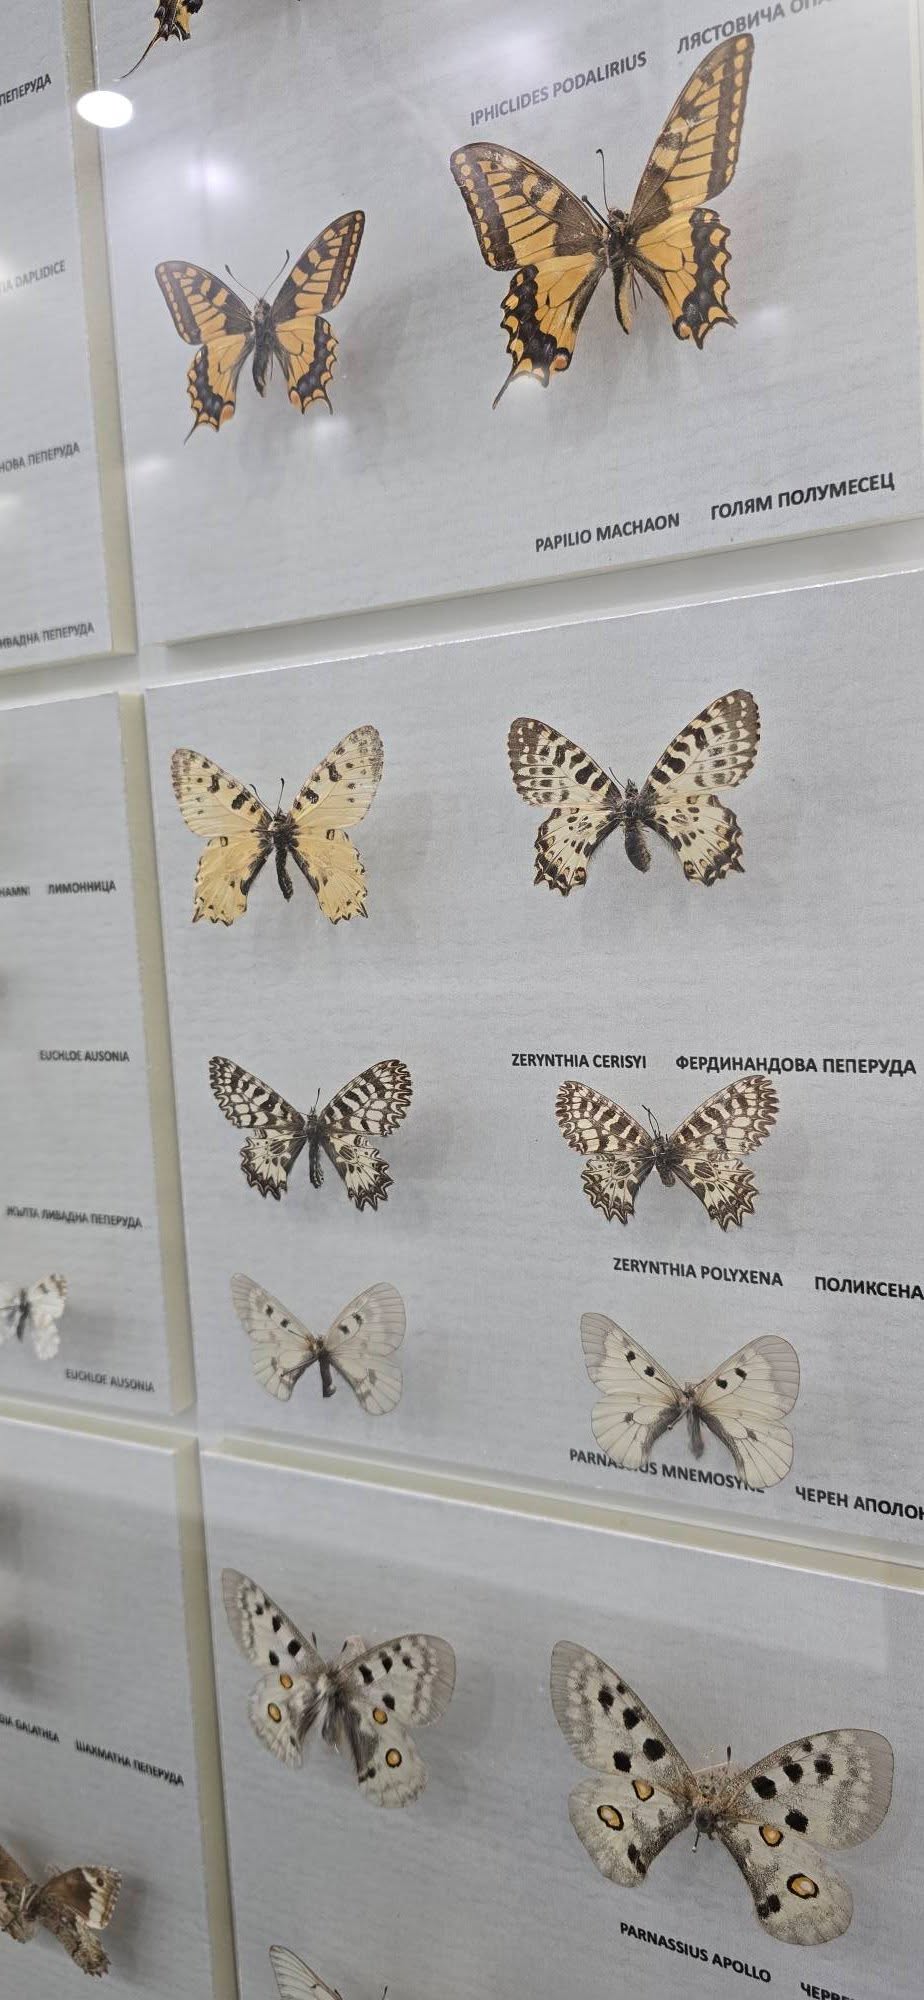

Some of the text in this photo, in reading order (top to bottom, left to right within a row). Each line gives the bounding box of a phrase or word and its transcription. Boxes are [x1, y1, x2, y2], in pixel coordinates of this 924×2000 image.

[677, 3, 785, 54] ЛЯСТОВИЧА
[0, 73, 52, 106] ПЕПЕРУДА
[470, 51, 647, 127] IPHICLIDES PODALIRIUS
[15, 259, 65, 288] DAPLIDICE
[28, 442, 80, 466] ПЕПЕРУДА
[711, 472, 895, 520] ГОЛЯМ ПОЛУМЕСЕЦ
[535, 513, 680, 552] PAPILIO MACHAON
[42, 621, 95, 642] ПЕПЕРУДА
[48, 880, 117, 895] ЛИМОННИЦА
[40, 1050, 129, 1062] EUCHLOE AUSONIA
[511, 1053, 646, 1069] ZERYNTHIA CERISYI
[675, 1055, 916, 1077] ФЕРДИНАНДОВА ПЕПЕРУДА
[41, 1209, 88, 1224] ЛИВАДНА
[91, 1213, 143, 1230] ПЕПЕРУДА
[613, 1257, 783, 1287] ZERYNTHIA POLYXENA
[815, 1276, 924, 1300] ПОЛИКСЕНА
[66, 1368, 154, 1392] EUCHLOE AUSONIA
[570, 1448, 658, 1475] PARNAUS
[795, 1485, 848, 1508] ЧЕРЕН
[15, 1719, 60, 1743] GALATHEA
[75, 1739, 184, 1786] ШАХМАТНА ПЕПЕРУДА
[620, 1922, 772, 1983] PARNASSIUS APOLLO
